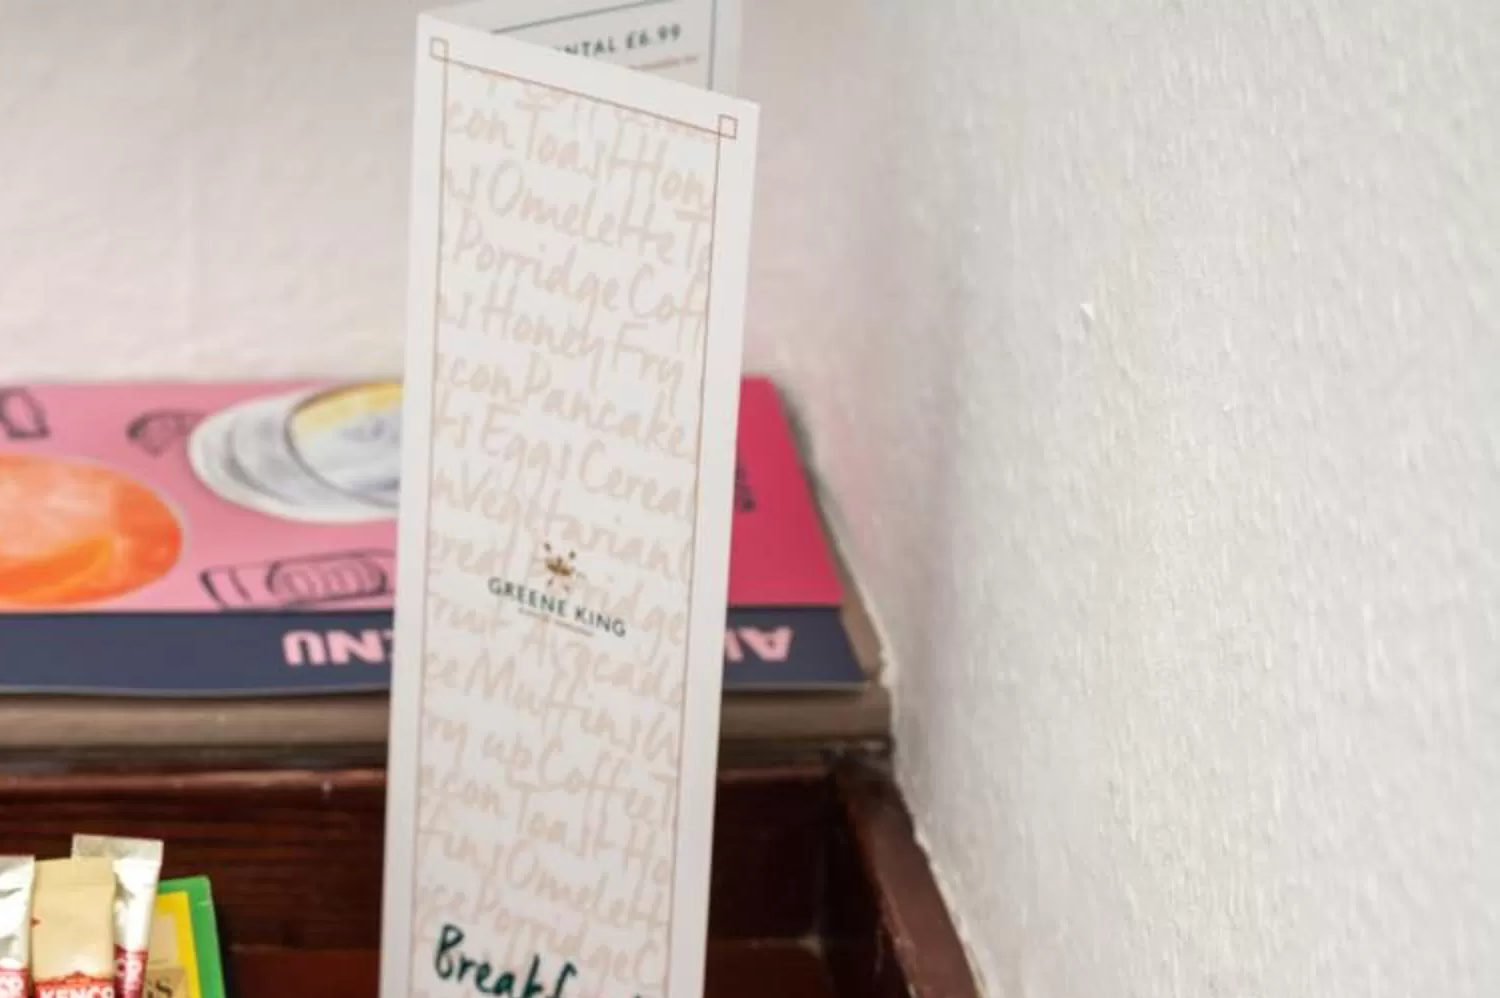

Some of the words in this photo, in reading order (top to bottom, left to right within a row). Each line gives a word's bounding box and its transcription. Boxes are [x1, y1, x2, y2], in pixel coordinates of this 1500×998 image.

[554, 35, 617, 57] NTAL
[487, 576, 568, 618] GREENE
[574, 604, 627, 639] KING
